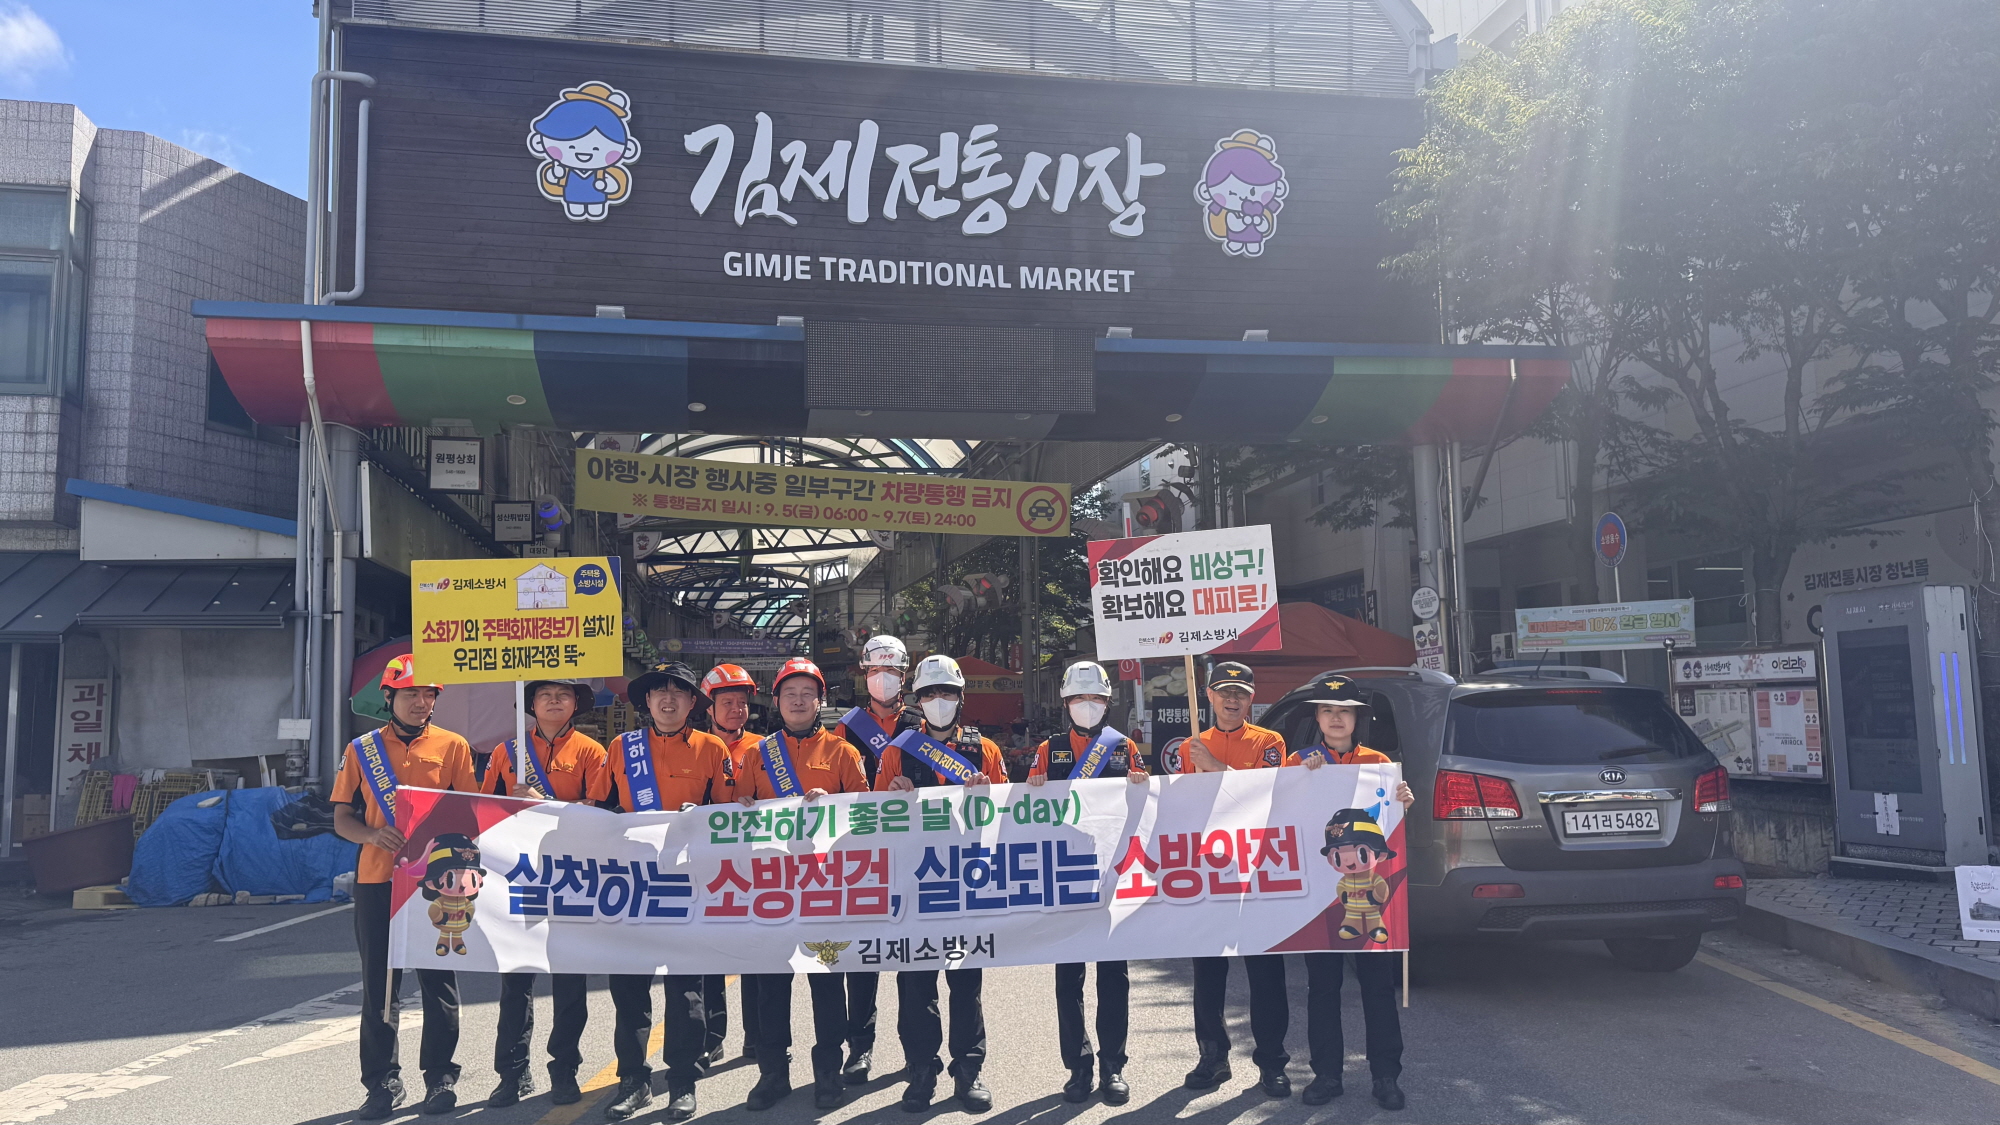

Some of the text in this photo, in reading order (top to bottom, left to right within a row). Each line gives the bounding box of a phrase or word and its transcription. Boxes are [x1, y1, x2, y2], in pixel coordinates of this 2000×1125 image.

[722, 250, 1135, 294] GIMJE TRADITIONAL MARKET
[435, 452, 476, 465] 원평상회
[705, 465, 778, 496] 행사중
[785, 472, 875, 503] 일부구간
[881, 480, 966, 507] 차량통행
[972, 485, 1013, 509] 금지
[653, 493, 717, 513] 통행금지
[721, 499, 752, 515] 일시
[823, 507, 868, 522] 06:00
[881, 511, 932, 528] 9.7(토)
[933, 513, 976, 527] 24:00
[529, 547, 548, 555] 대장간
[1600, 533, 1620, 545] 소방용수
[579, 569, 601, 578] 주택용
[1099, 548, 1265, 588] 확인해요 비상구!
[1803, 558, 1929, 591] 김제전통시장 청년몰
[452, 577, 507, 591] 김제소방서
[577, 578, 605, 589] 소방시설
[1101, 583, 1268, 622] 확보해요 대피로!
[421, 615, 615, 644] 소화기와 주택화재경보기 설치!
[1527, 612, 1682, 634] 디지털온누리 10% 환급 행사
[1178, 628, 1238, 643] 김제소방서
[453, 647, 498, 672] 우리집
[501, 645, 560, 670] 화재걱정
[1421, 657, 1441, 671] 서문
[70, 683, 108, 733] 과일
[1157, 708, 1206, 724] 차량통행지
[1604, 772, 1623, 781] KIA
[708, 789, 1082, 844] 안전하기 좋은 날 (D-day)
[1571, 811, 1655, 831] 141러 5482
[505, 824, 1303, 919] 실천하는 소방점검, 실현되는 소방안전
[857, 933, 996, 965] 김제소방서
